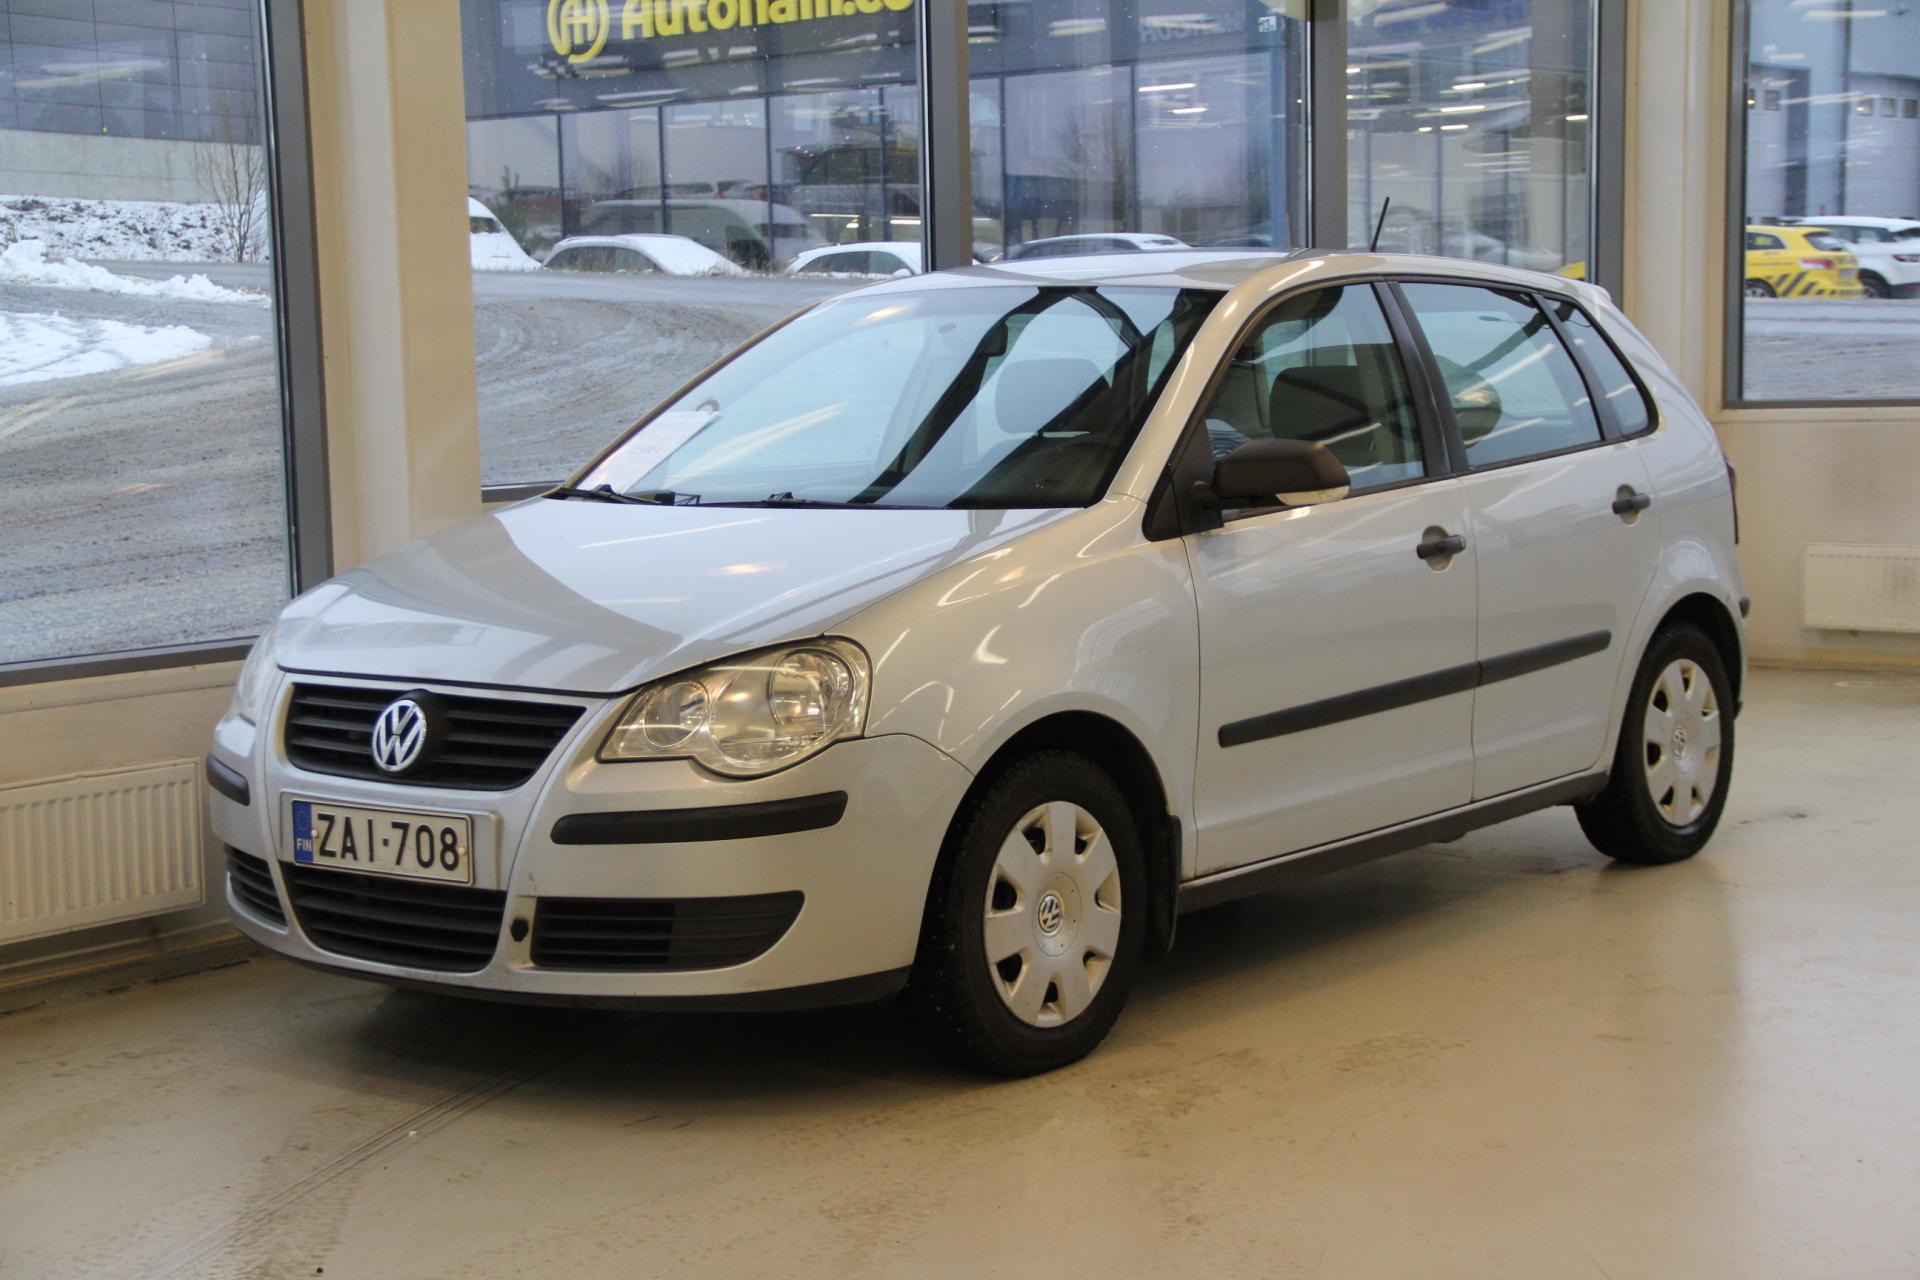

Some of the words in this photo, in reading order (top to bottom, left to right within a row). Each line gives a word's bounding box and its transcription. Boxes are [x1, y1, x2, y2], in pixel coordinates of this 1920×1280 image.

[373, 700, 426, 772] VW
[297, 838, 313, 853] FIN
[318, 813, 459, 871] ZAI-708
